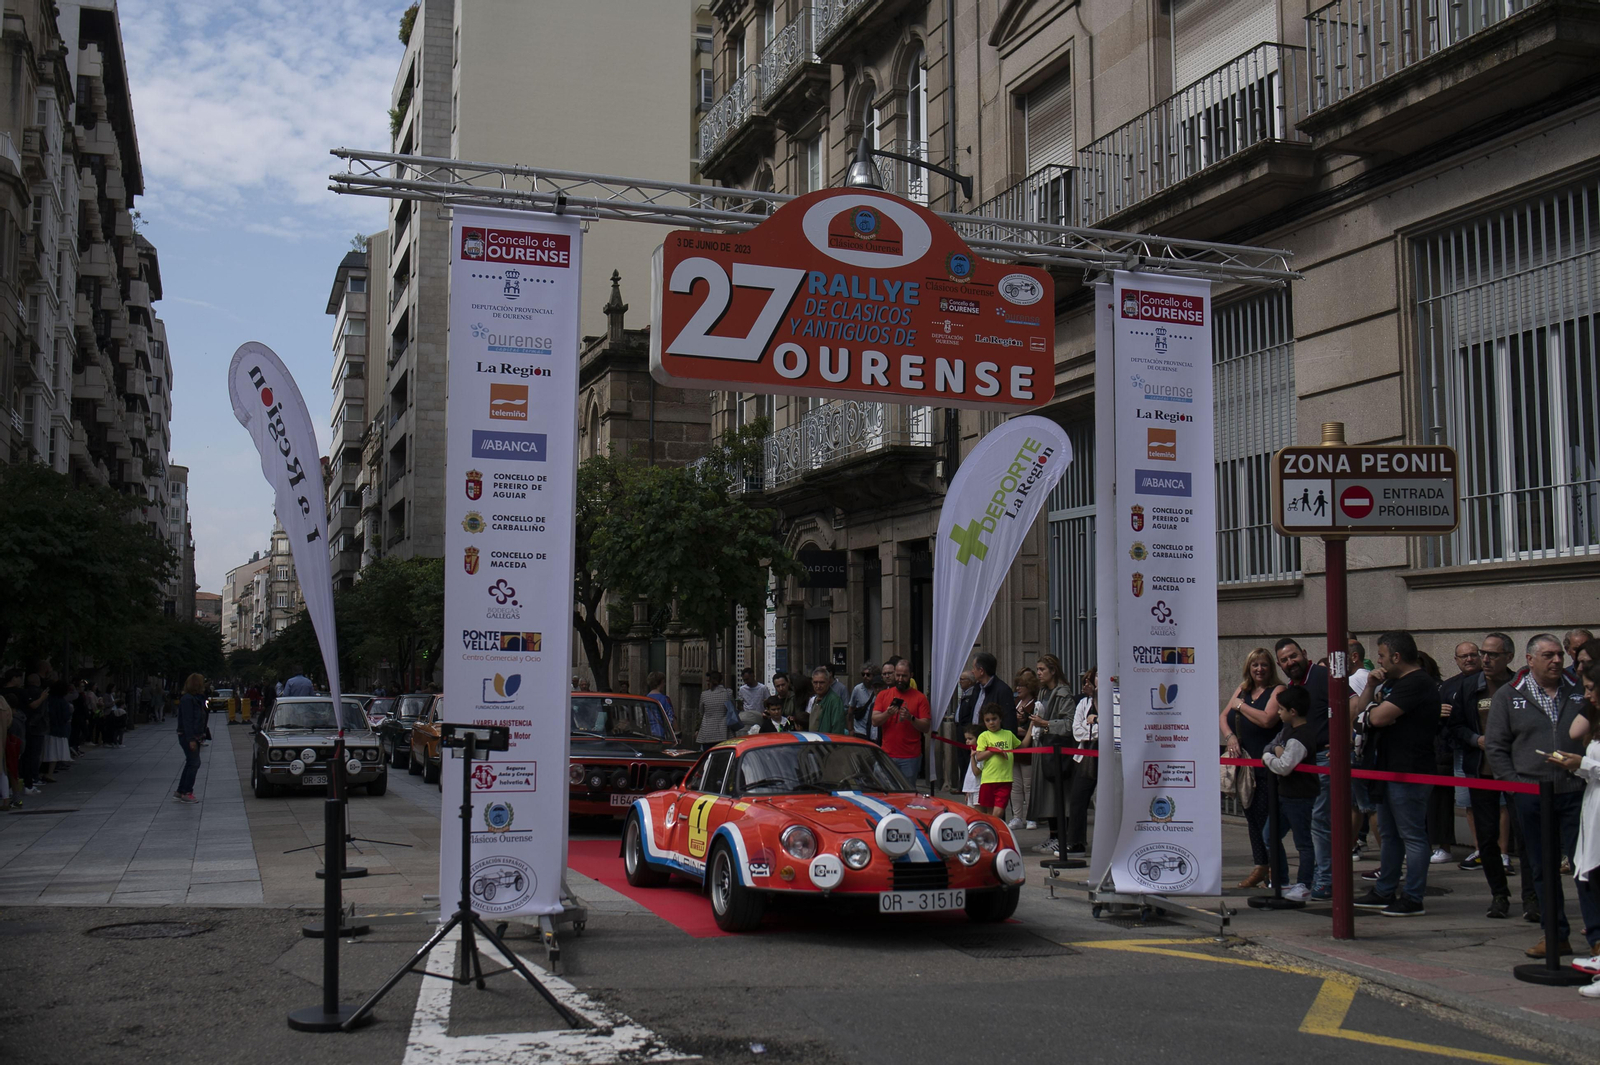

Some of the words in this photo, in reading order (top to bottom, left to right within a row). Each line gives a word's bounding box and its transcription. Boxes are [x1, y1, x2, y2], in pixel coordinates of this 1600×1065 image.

[488, 232, 538, 247] Concello
[542, 237, 556, 249] de
[829, 238, 864, 250] Clásicos
[865, 241, 900, 253] Ourense
[677, 238, 682, 247] 3
[683, 238, 694, 248] DE
[695, 240, 719, 251] JUNIO
[720, 242, 731, 252] DE
[734, 244, 751, 254] 2023
[487, 245, 569, 264] OURENSE
[808, 270, 920, 305] RALLYE
[925, 281, 959, 293] Clásicos
[960, 285, 994, 297] Ourense
[1141, 294, 1180, 307] Concello
[1182, 299, 1193, 308] de
[514, 306, 554, 315] PROVINCIAL
[665, 257, 807, 363] 27
[804, 298, 828, 317] DE
[831, 300, 912, 326] CLASICOS
[948, 304, 980, 314] OURENSE
[1141, 305, 1203, 322] OURENSE
[502, 313, 533, 321] OURENSE
[1004, 313, 1040, 322] ourense
[790, 318, 802, 336] Y
[802, 319, 891, 344] ANTIGUOS
[893, 328, 917, 347] DE
[488, 333, 552, 349] ourense
[935, 338, 960, 346] OURENSE
[975, 333, 989, 343] La
[989, 335, 1023, 347] Región
[476, 361, 496, 373] La
[500, 362, 551, 378] Región
[772, 342, 1034, 400] OURENSE
[1144, 383, 1193, 398] ourense
[491, 409, 526, 418] telemiño
[1136, 408, 1152, 419] La
[1154, 409, 1193, 423] Región
[1283, 454, 1351, 473] ZONA
[1361, 453, 1452, 473] PEONIL
[493, 473, 534, 481] CONCELLO
[493, 482, 528, 490] PEREIRO
[1004, 498, 1023, 520] La
[1016, 446, 1055, 497] Región
[492, 491, 526, 499] AGUIAR
[1383, 488, 1444, 499] ENTRADA
[1152, 507, 1183, 515] CONCELLO
[1378, 505, 1450, 516] PROHIBIDA
[492, 514, 533, 523] CONCELLO
[1152, 515, 1179, 523] PEREIRO
[492, 523, 545, 532] CARBALLIÑO
[1152, 543, 1183, 551] CONCELLO
[491, 551, 534, 559] CONCELLO
[536, 552, 547, 560] DE
[1152, 551, 1193, 559] CARBALLIÑO
[490, 561, 527, 569] MACEDA
[462, 630, 499, 641] PONTE
[463, 640, 499, 651] VELLA
[1133, 646, 1161, 655] PONTE
[485, 654, 518, 662] Comercial
[519, 655, 524, 663] y
[1133, 655, 1161, 664] VELLA
[1512, 700, 1527, 709] 27
[499, 719, 533, 727] ASISTENCIA
[513, 731, 531, 740] Motor
[1173, 734, 1189, 742] Motor
[611, 795, 619, 805] H
[696, 799, 708, 834] 1
[1162, 824, 1194, 832] Ourense
[470, 835, 497, 844] lásicos
[499, 834, 533, 843] Ourense
[690, 838, 705, 851] PIRELLI
[470, 858, 501, 872] EDERACIÓN
[502, 858, 528, 872] ESPAÑOLA
[882, 894, 902, 911] OR
[919, 891, 963, 910] 31516
